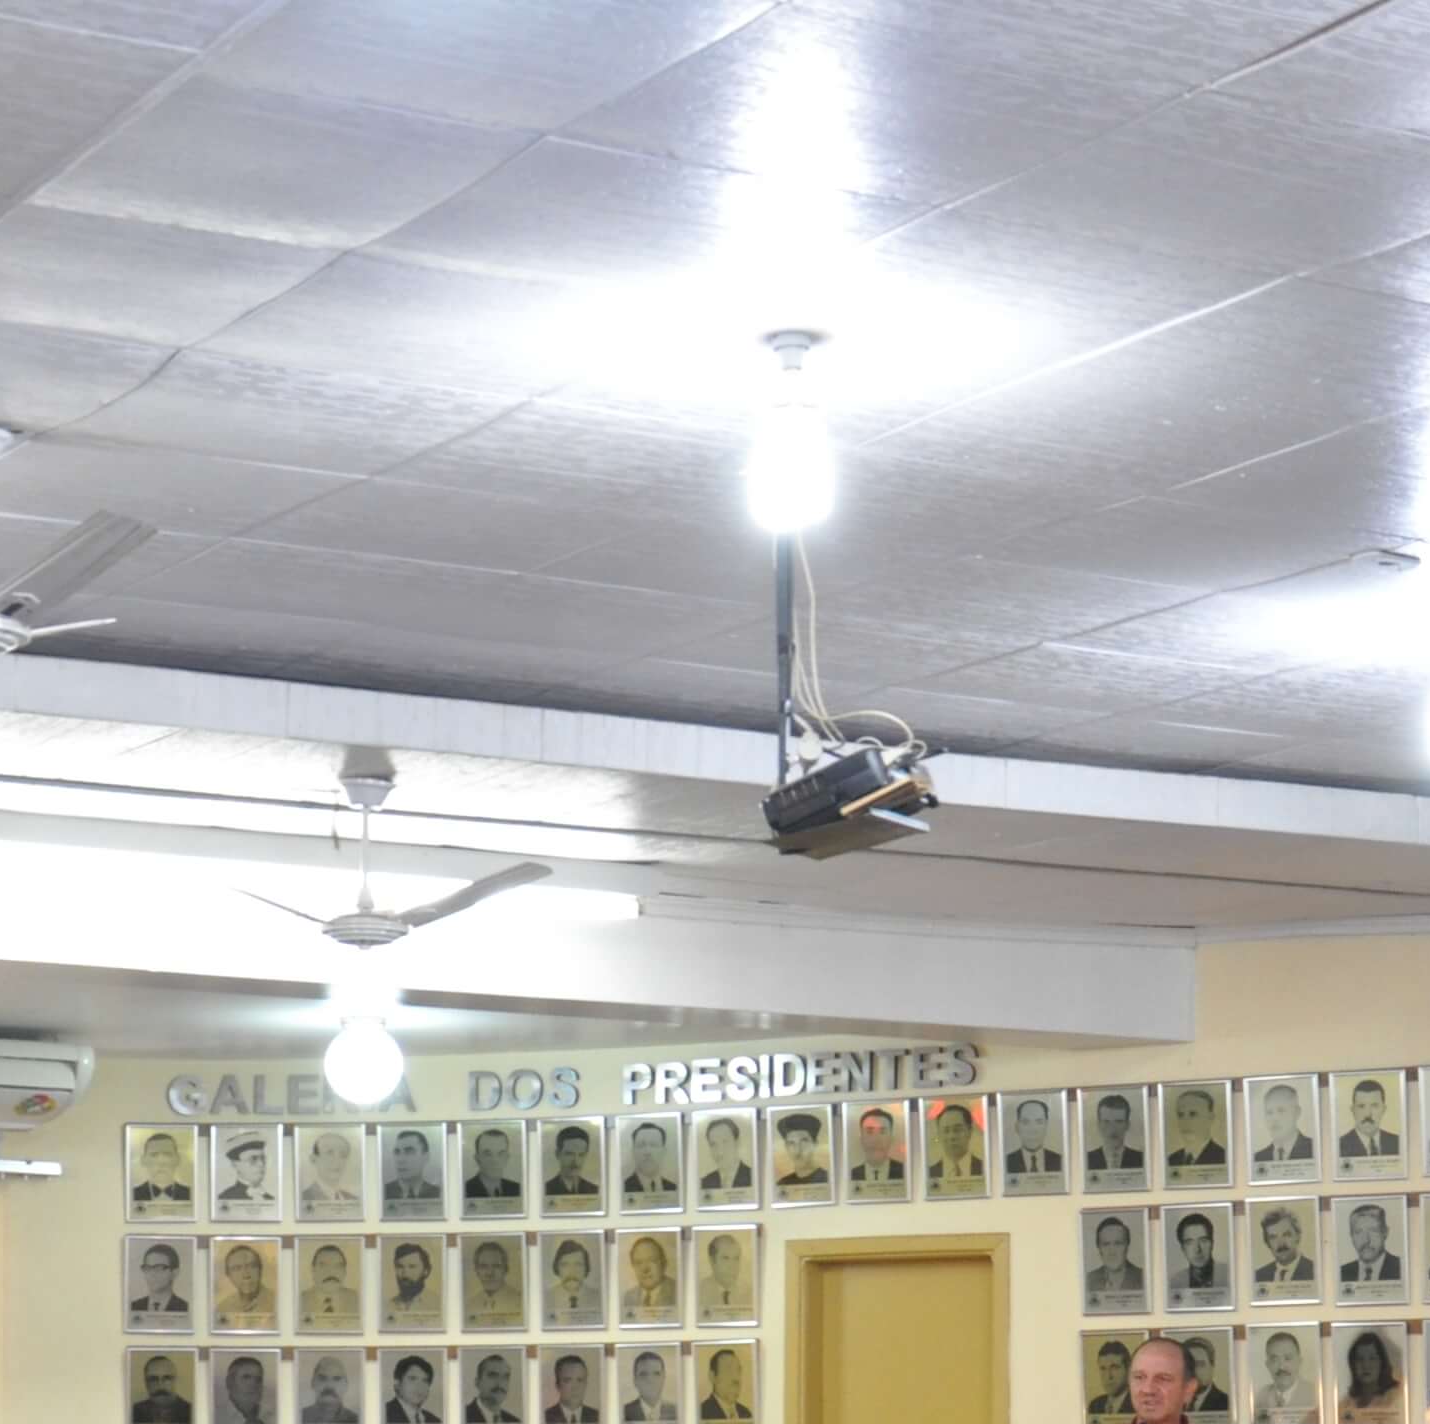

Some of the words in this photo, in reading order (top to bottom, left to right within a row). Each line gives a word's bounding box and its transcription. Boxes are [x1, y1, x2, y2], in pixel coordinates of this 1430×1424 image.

[166, 1072, 418, 1117] GALEA
[468, 1066, 582, 1112] DOS
[621, 1042, 982, 1107] PRESIDENTES
